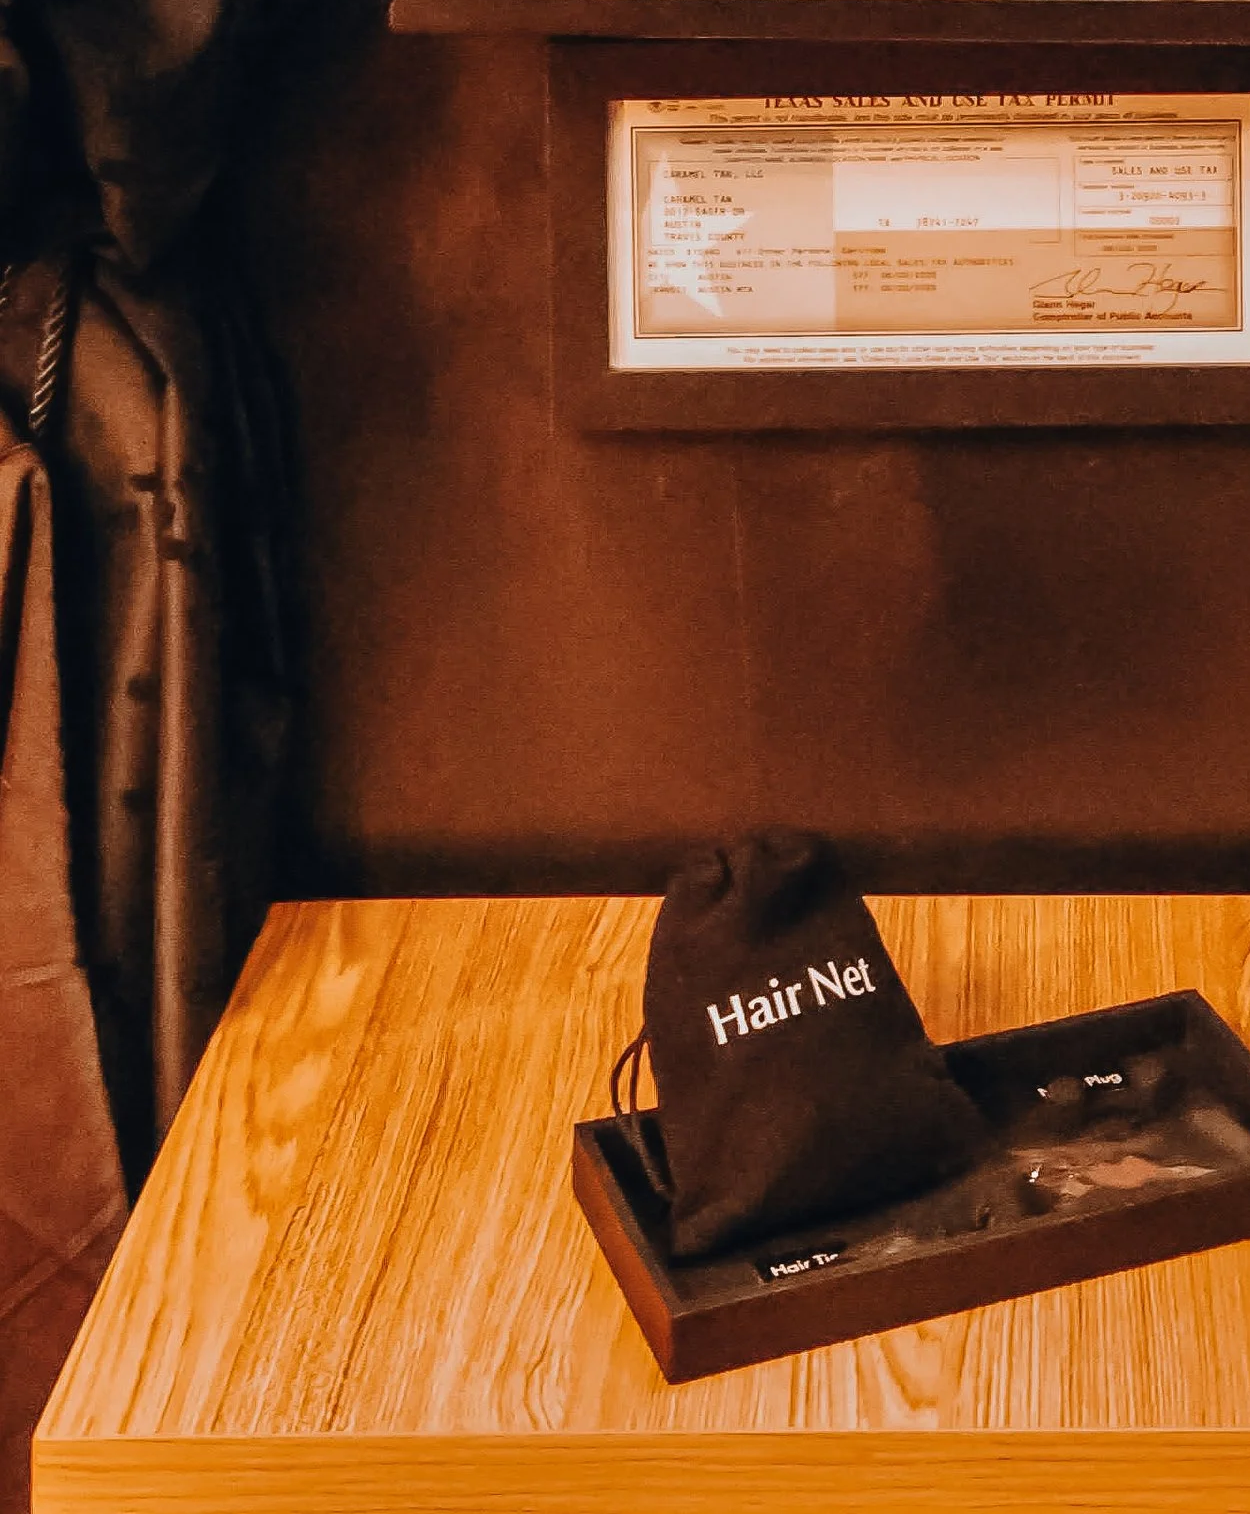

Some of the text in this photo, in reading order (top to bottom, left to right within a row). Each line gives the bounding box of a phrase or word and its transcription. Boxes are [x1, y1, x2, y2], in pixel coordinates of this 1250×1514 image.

[764, 94, 1114, 109] TEXAS SALES AND USE TAX PERMIT
[707, 957, 876, 1045] Hair Net
[1084, 1074, 1122, 1087] Plug
[770, 1260, 810, 1276] Hair
